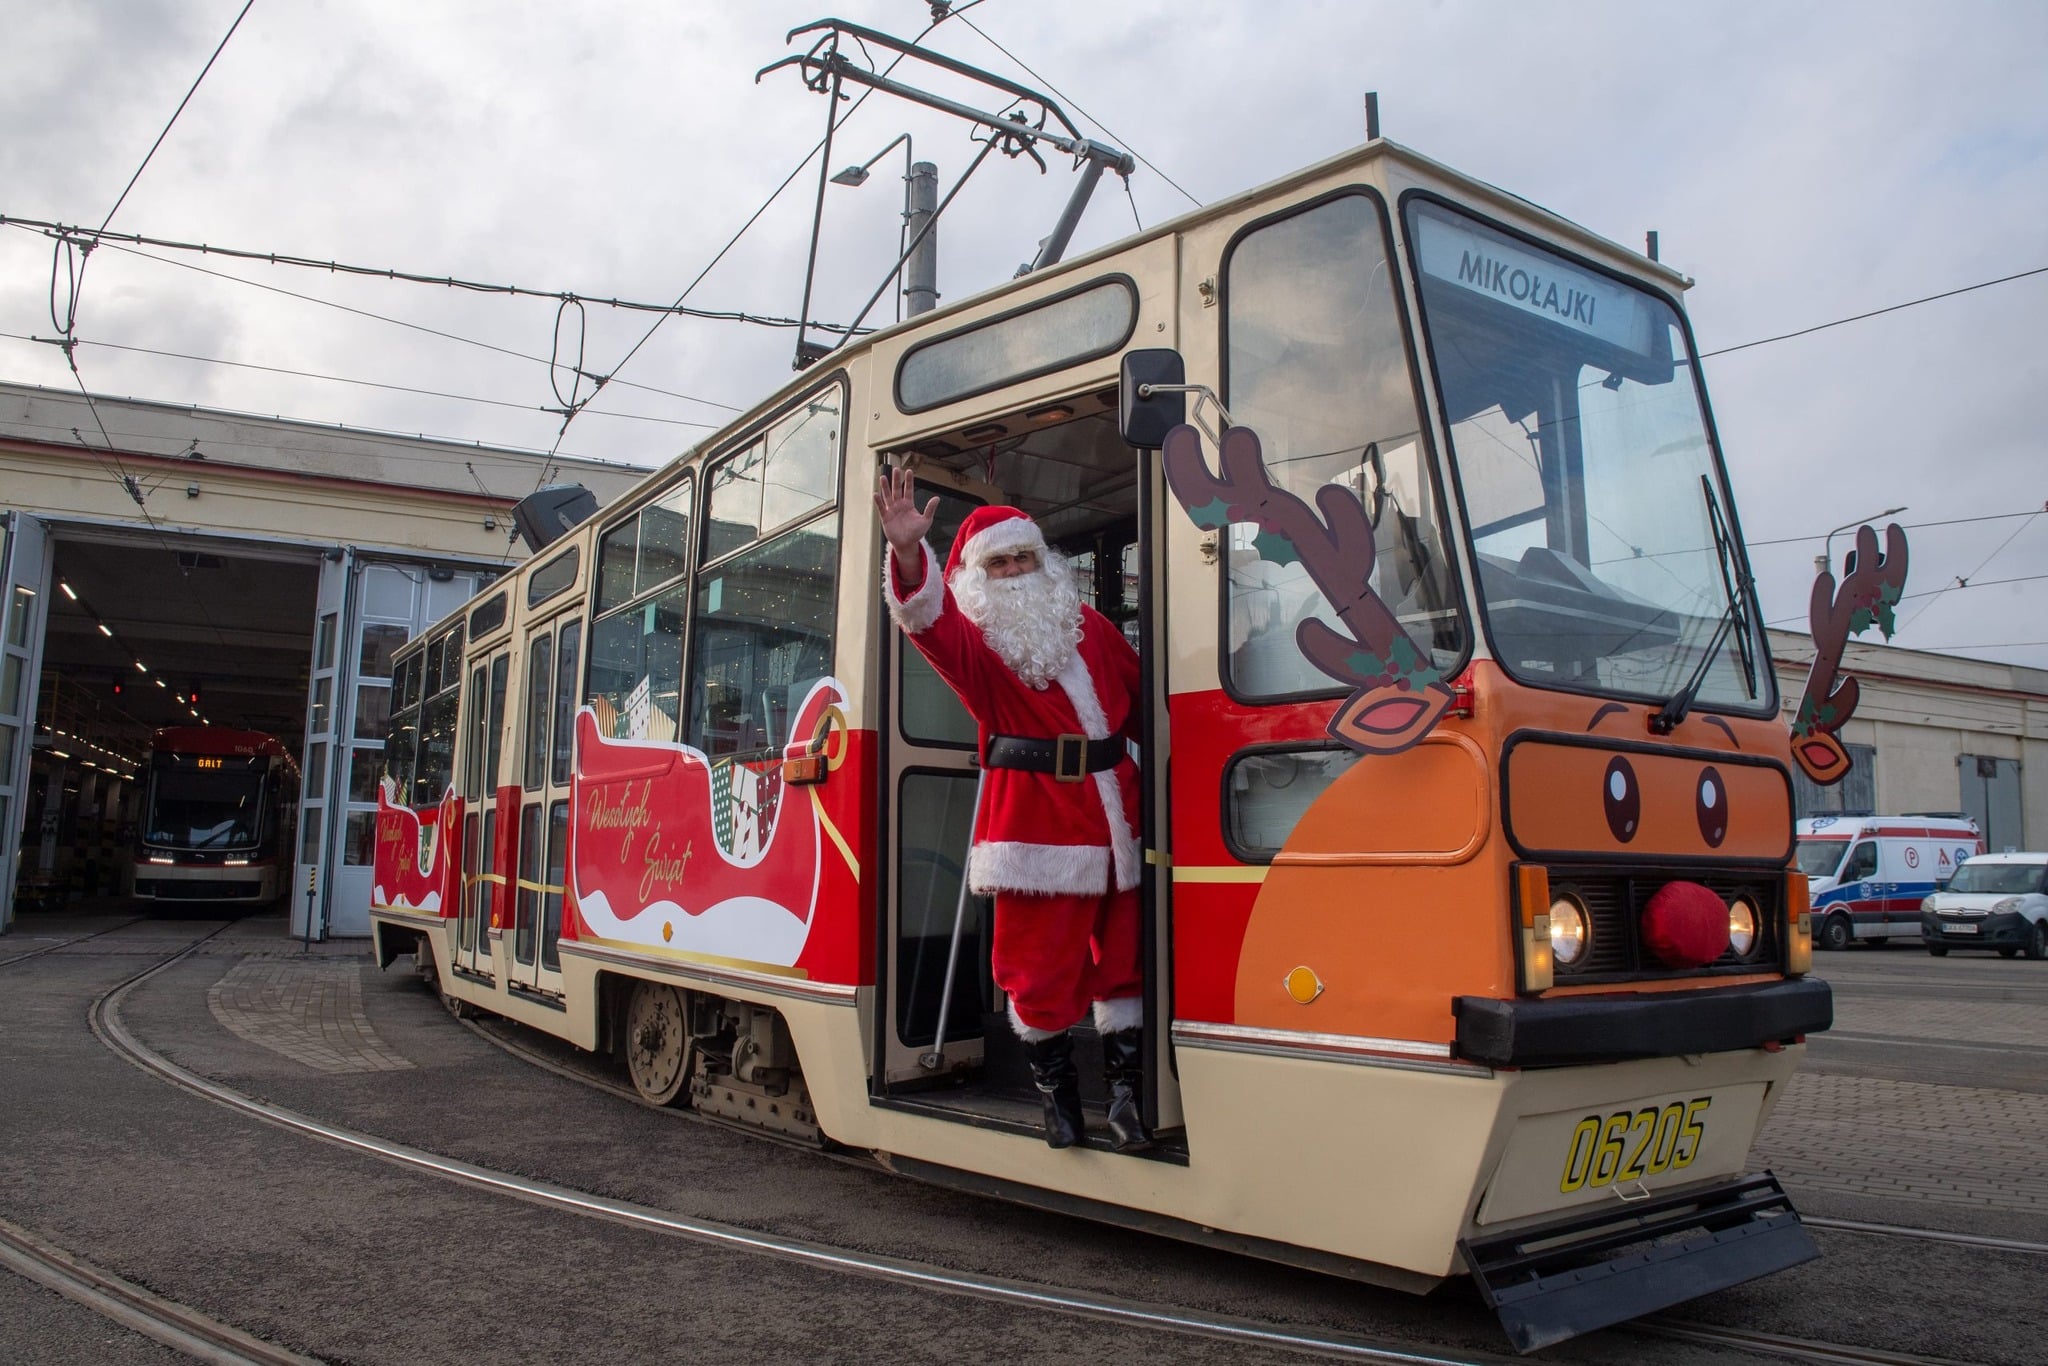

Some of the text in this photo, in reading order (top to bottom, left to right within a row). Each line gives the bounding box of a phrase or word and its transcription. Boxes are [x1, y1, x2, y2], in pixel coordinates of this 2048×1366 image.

[1458, 250, 1596, 326] MIKOŁAJKI
[587, 779, 653, 864] Wesołych
[639, 818, 693, 903] Świąt
[1559, 1096, 1712, 1194] 06205
